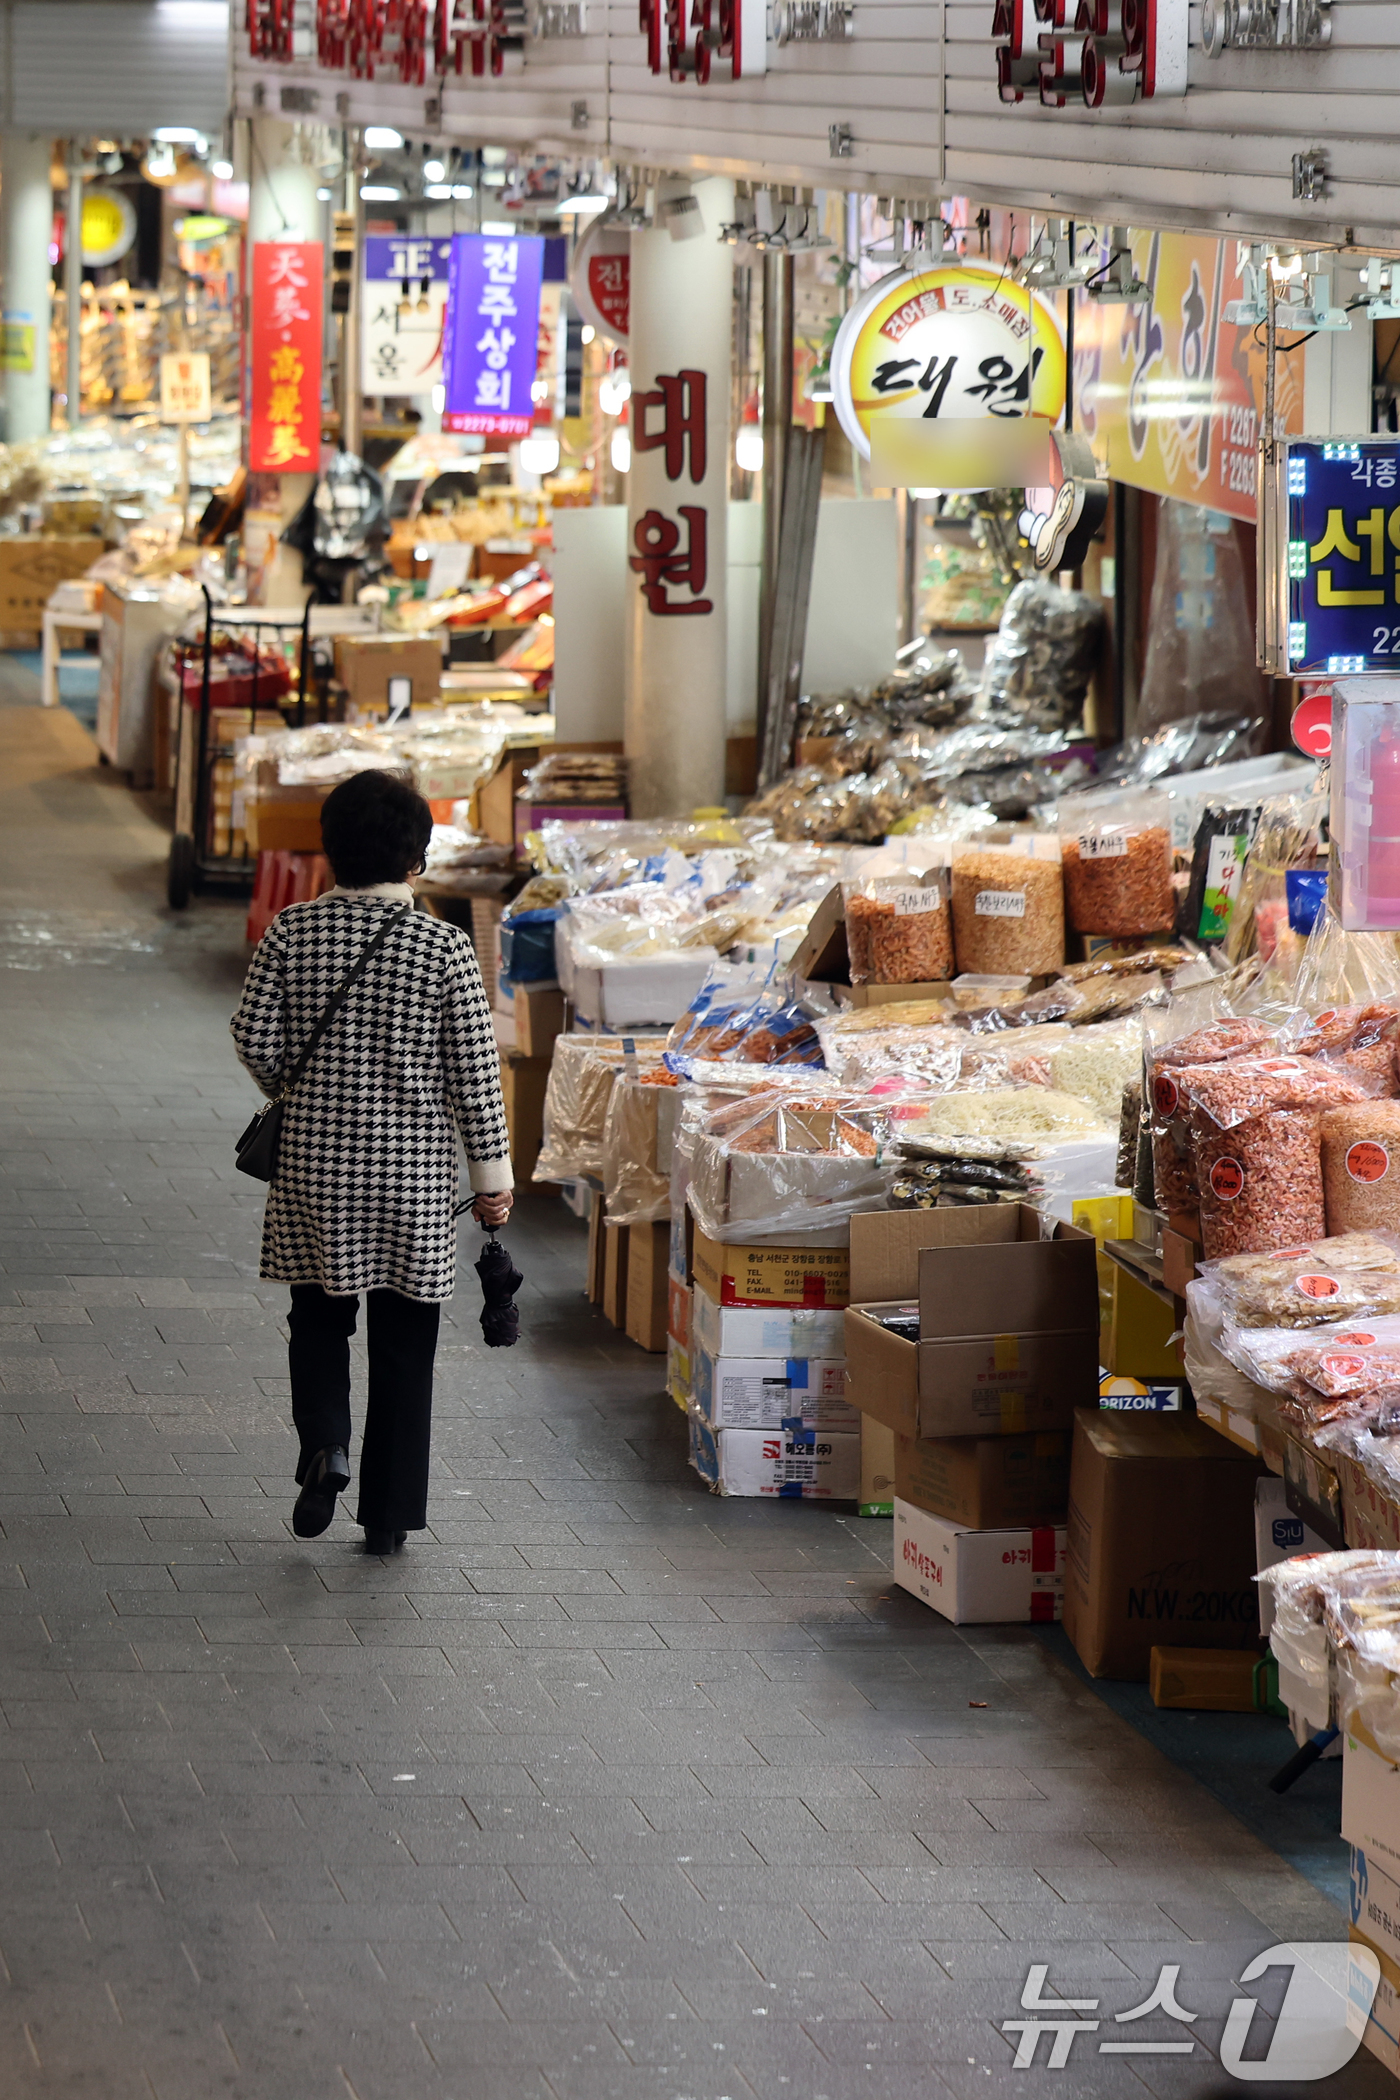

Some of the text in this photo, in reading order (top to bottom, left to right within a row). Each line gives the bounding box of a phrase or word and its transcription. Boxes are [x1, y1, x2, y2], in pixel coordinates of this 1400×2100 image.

[475, 242, 518, 411] 전주상회
[886, 289, 939, 338] 건어물
[871, 346, 1044, 418] 대원
[629, 369, 713, 616] 대원
[1350, 458, 1398, 488] 각종
[1310, 507, 1400, 607] 선
[1214, 865, 1235, 919] 다시마
